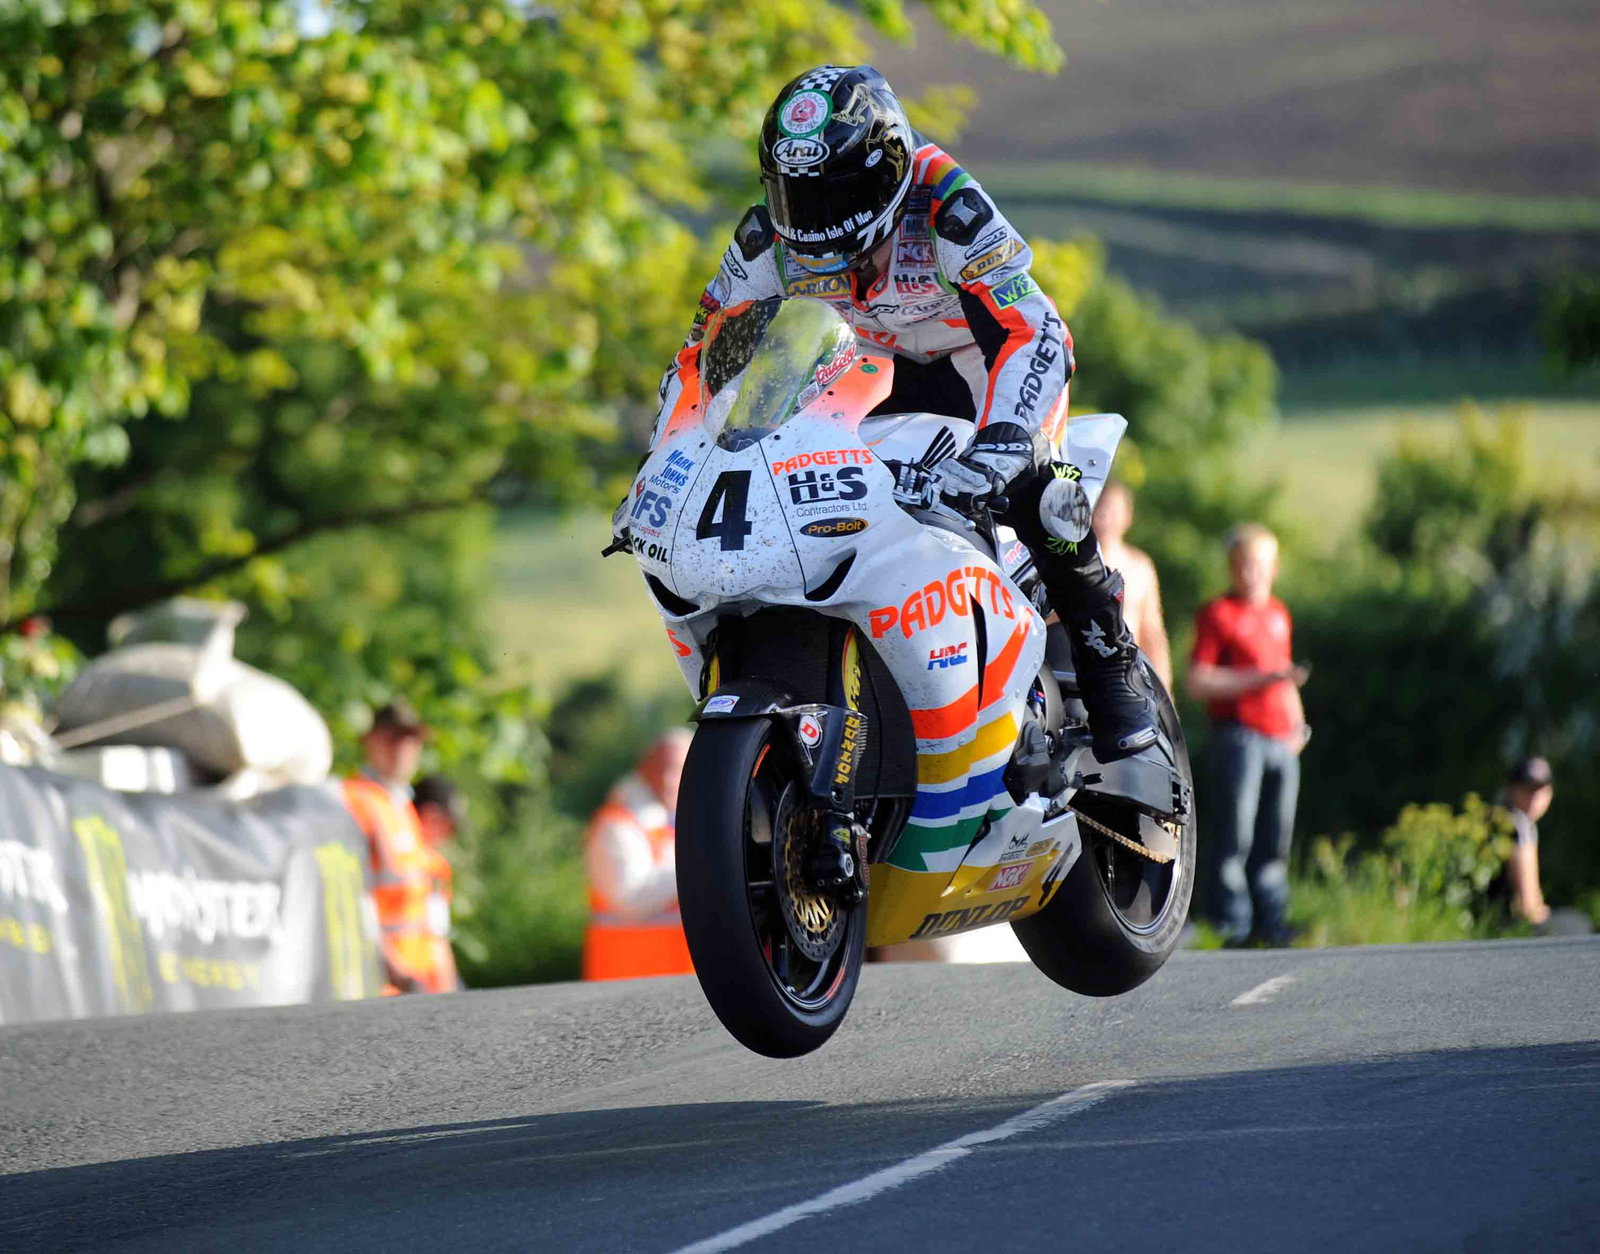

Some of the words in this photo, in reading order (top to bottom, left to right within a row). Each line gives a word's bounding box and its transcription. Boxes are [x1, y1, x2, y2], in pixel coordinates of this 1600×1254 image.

[777, 141, 820, 158] Arai
[797, 229, 826, 242] Casino
[825, 225, 844, 240] Isle
[843, 218, 855, 232] Of
[855, 210, 874, 226] Man
[898, 242, 936, 263] NGK
[665, 449, 696, 472] MARK
[771, 449, 874, 477] PADGETTS
[649, 474, 681, 495] Motors
[660, 463, 689, 487] JOHNS
[788, 466, 868, 505] H&S
[696, 470, 753, 551] 4
[796, 504, 850, 518] Contractors
[807, 519, 862, 535] Pro-Bolt
[648, 543, 668, 563] OIL
[927, 642, 968, 671] HRC
[835, 716, 861, 784] DUNLOP
[990, 864, 1028, 890] NGK
[908, 896, 1031, 940] DUNLOP
